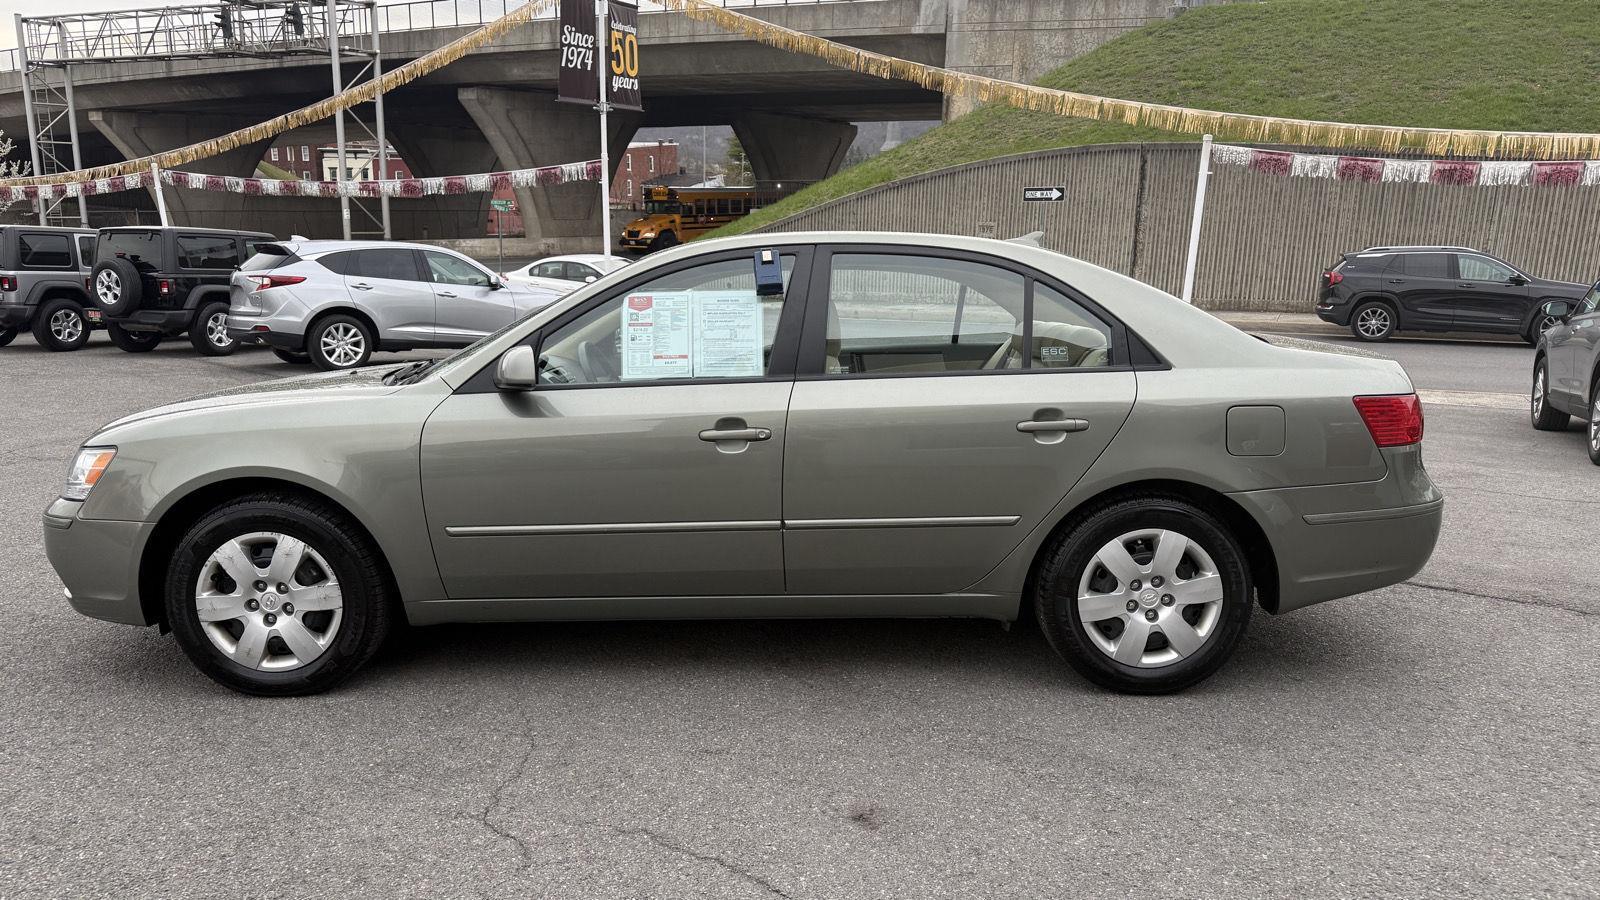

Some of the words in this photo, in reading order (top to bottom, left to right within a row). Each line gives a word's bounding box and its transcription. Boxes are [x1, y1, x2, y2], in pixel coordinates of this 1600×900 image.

[562, 25, 594, 48] Since
[561, 46, 593, 71] 1974
[612, 31, 639, 77] 50
[612, 75, 638, 92] years
